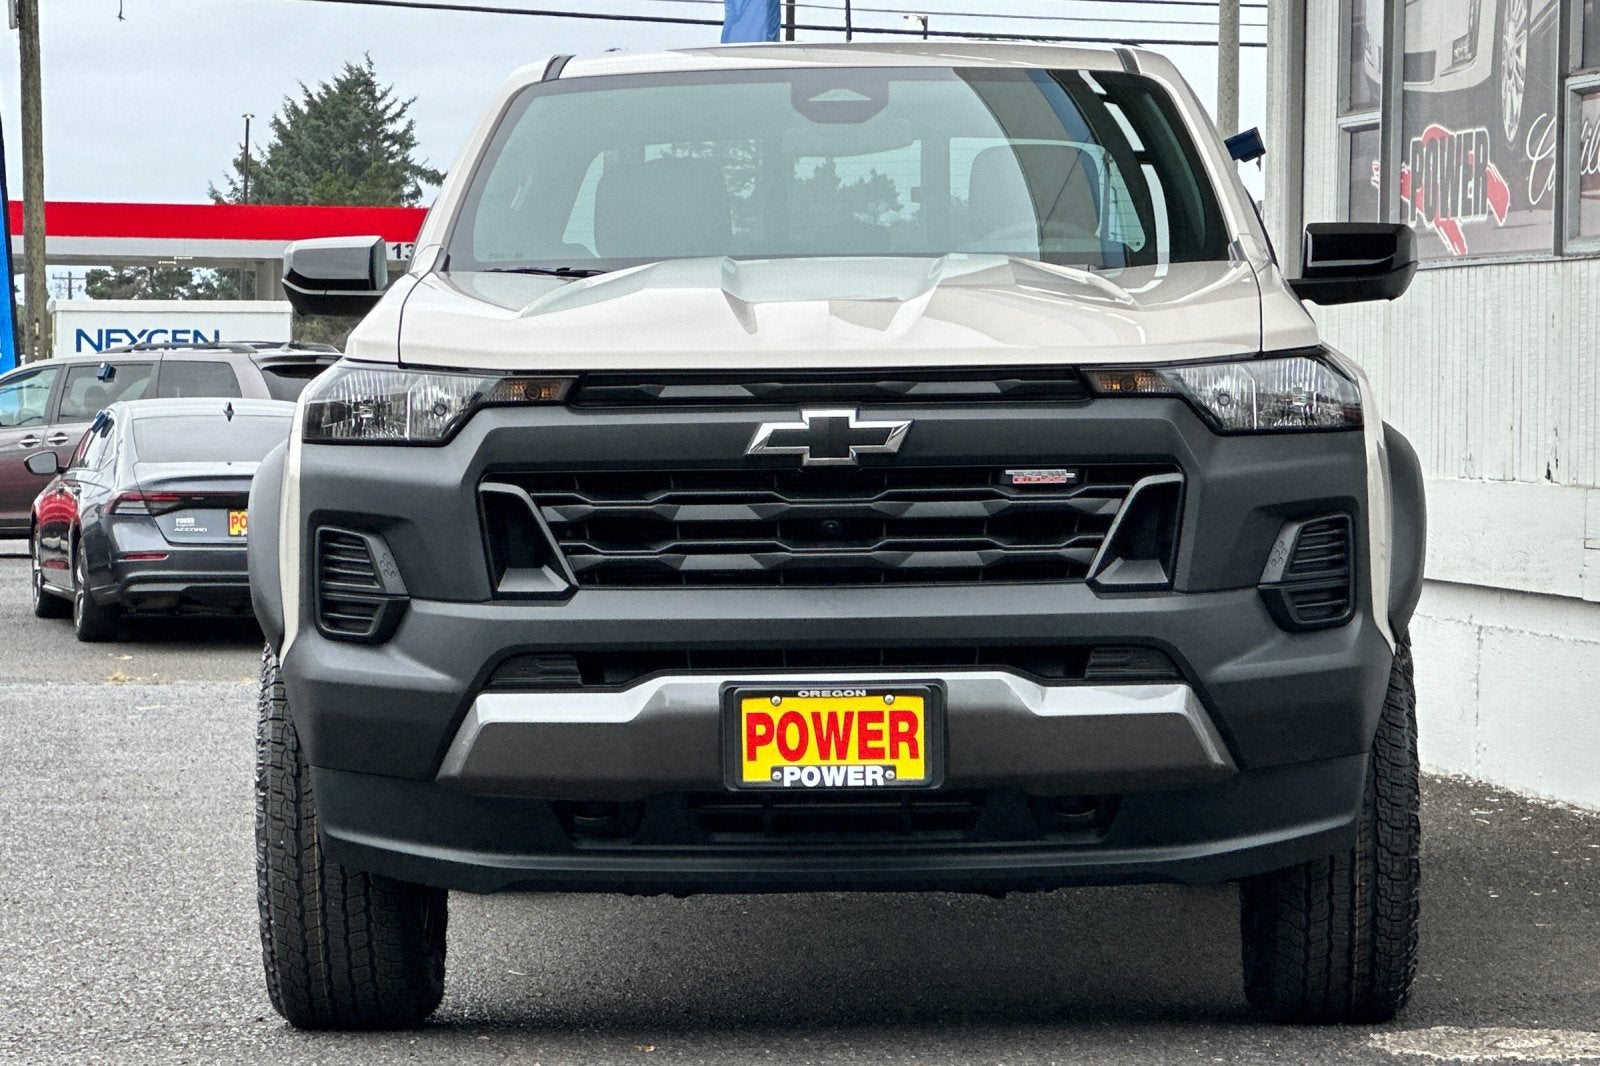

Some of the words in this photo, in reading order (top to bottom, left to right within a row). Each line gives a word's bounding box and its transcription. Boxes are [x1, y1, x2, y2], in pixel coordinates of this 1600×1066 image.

[1409, 127, 1490, 228] POWER
[797, 689, 867, 698] OREGON
[746, 710, 920, 762] POWER
[783, 765, 885, 787] POWER
